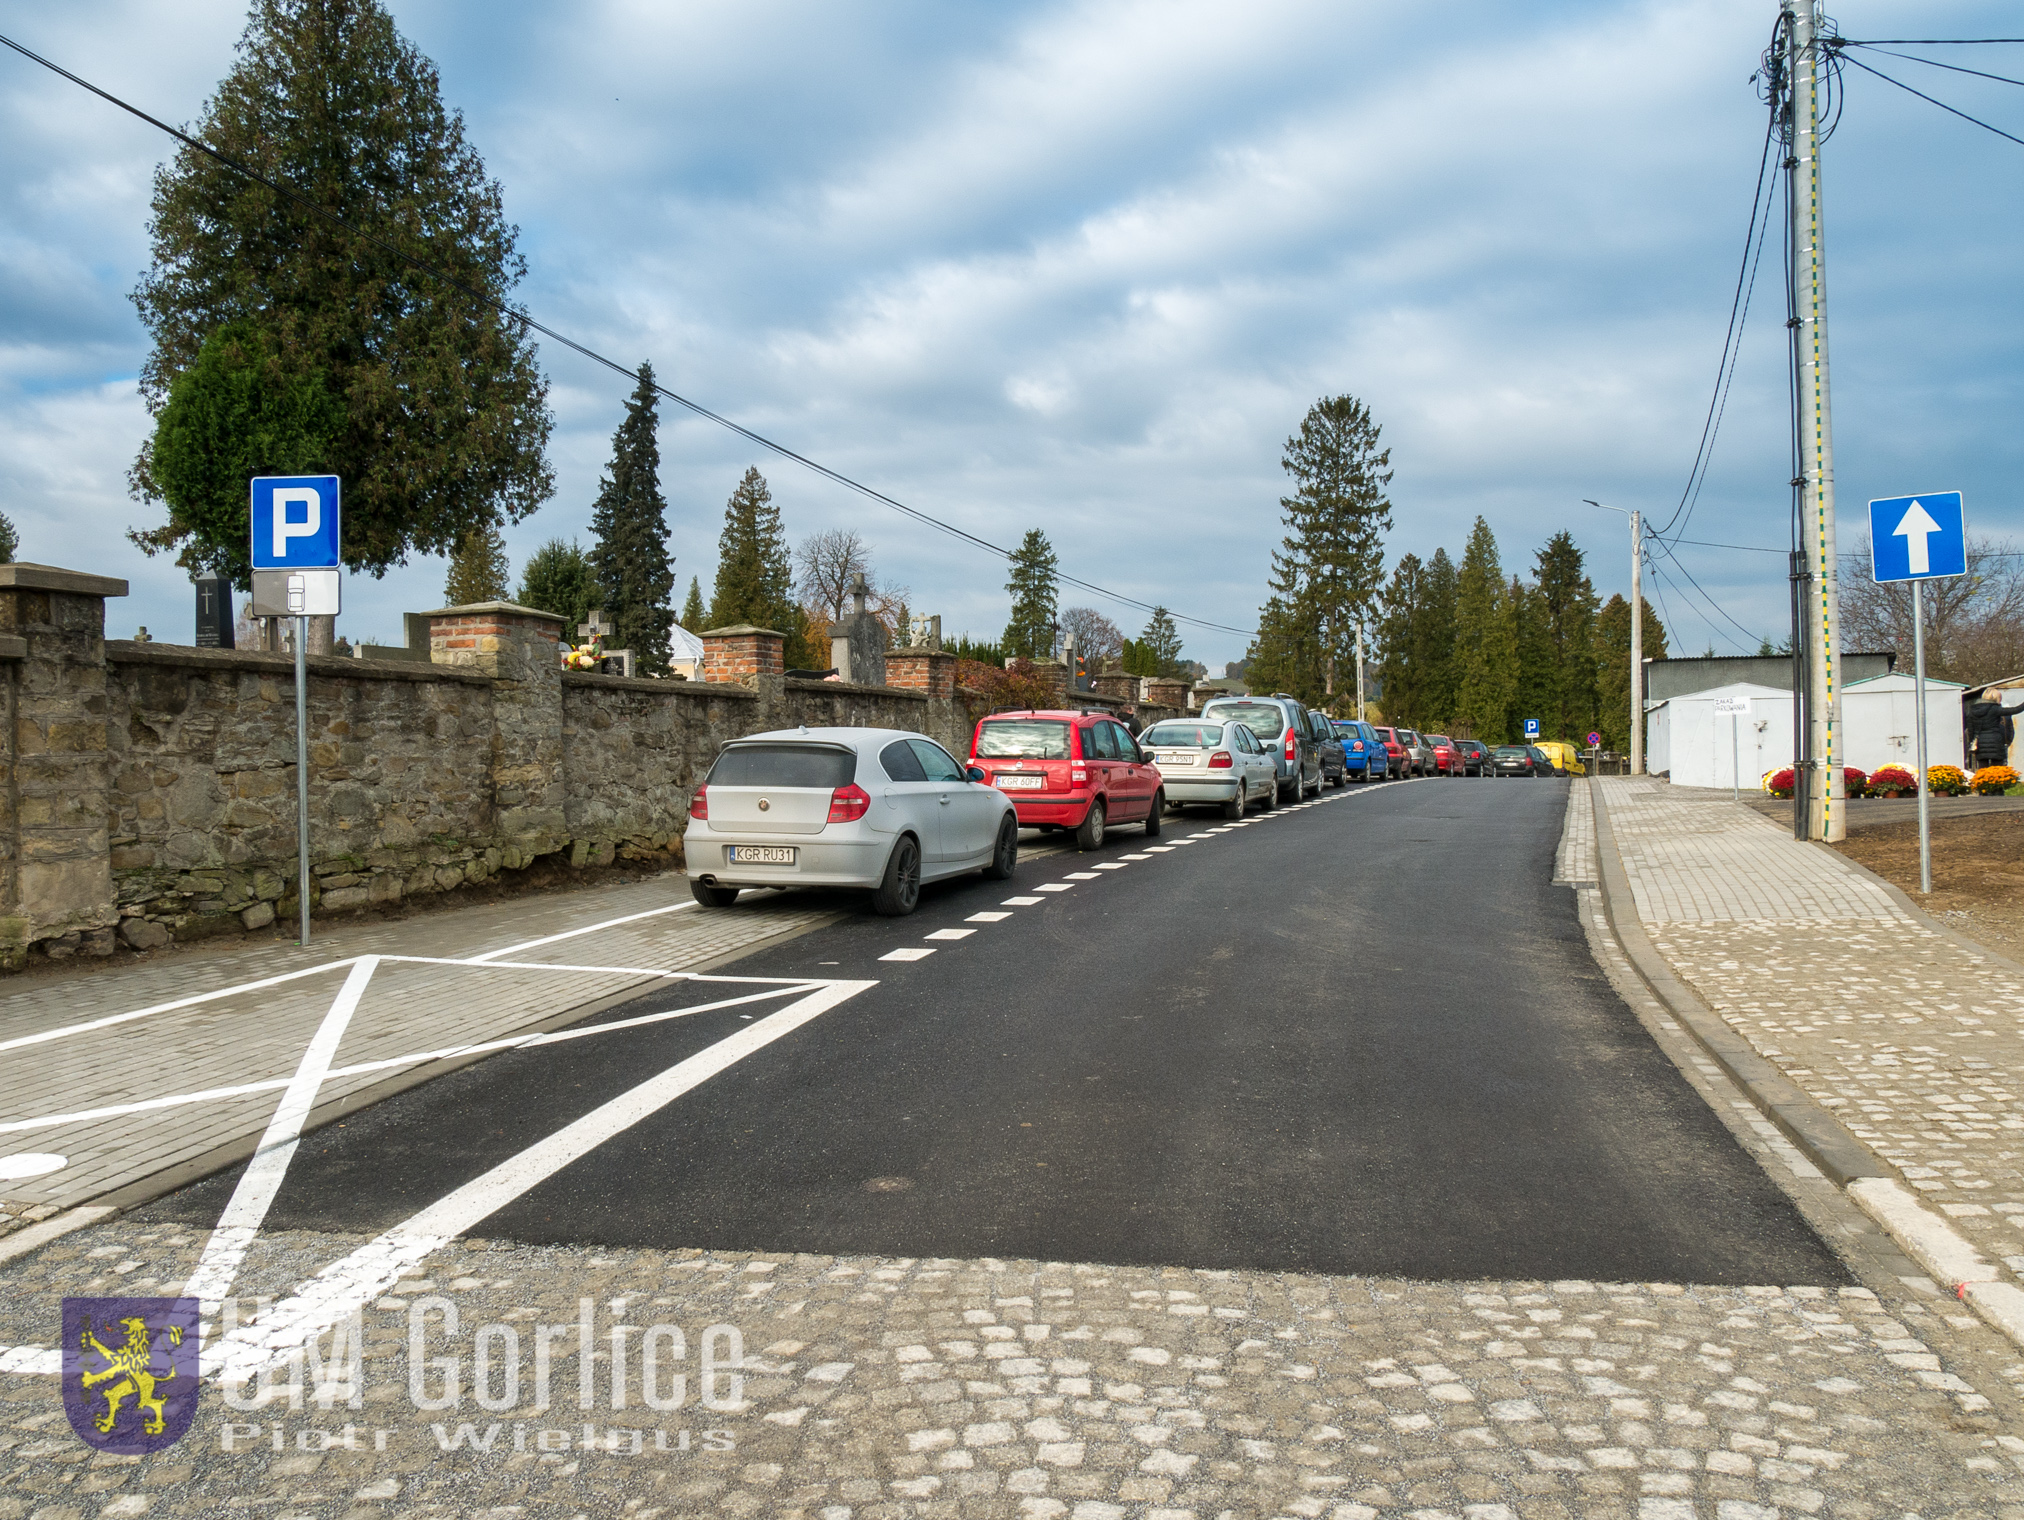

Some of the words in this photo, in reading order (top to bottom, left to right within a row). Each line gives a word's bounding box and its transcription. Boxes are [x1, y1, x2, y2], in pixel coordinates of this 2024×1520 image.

[272, 487, 321, 558] P
[1527, 720, 1537, 732] P
[1159, 755, 1174, 763] KGR
[1001, 777, 1019, 785] KGR
[1020, 777, 1041, 786] 60FF
[736, 848, 761, 861] KGR
[763, 848, 791, 861] RU31
